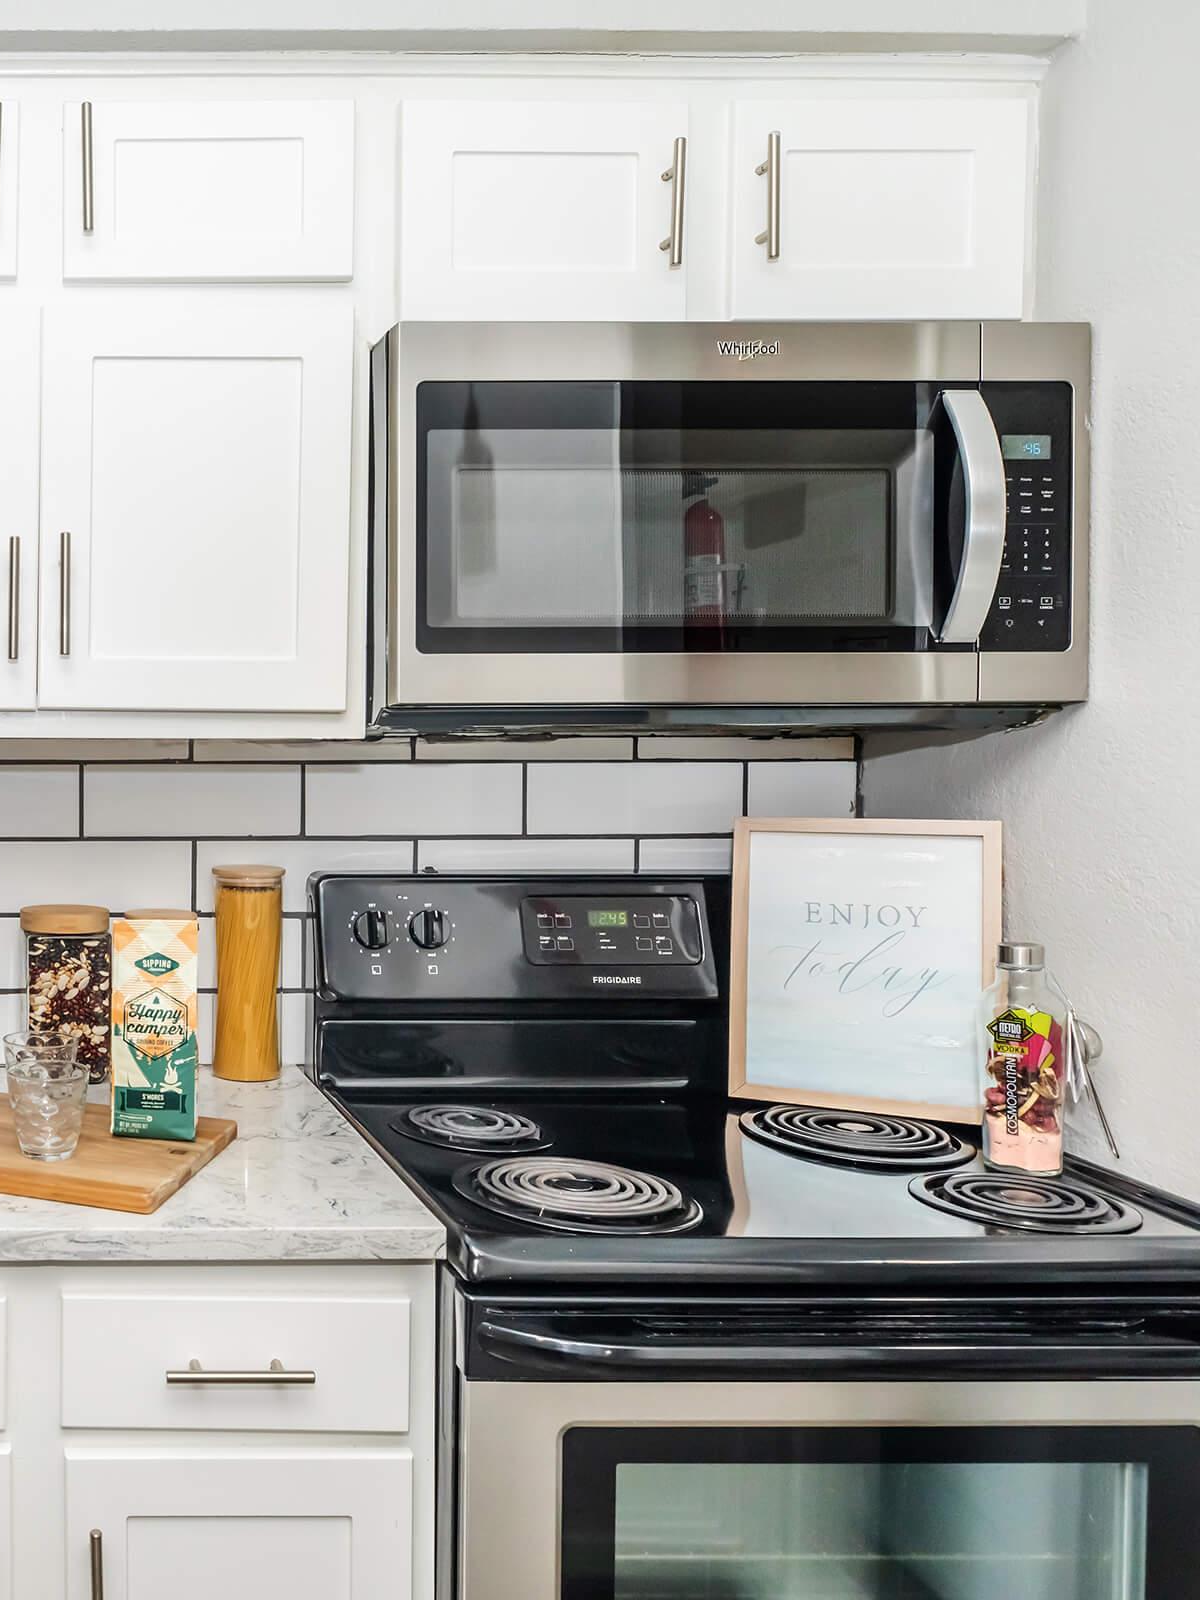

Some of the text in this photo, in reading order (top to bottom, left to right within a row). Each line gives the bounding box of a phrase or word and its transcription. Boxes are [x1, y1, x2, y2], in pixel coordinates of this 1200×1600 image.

[716, 340, 780, 359] Whirlpool
[804, 901, 928, 929] ENJOY
[142, 959, 172, 969] SIPPING
[592, 976, 642, 984] FRIGIDAIRE
[767, 930, 956, 1018] today
[129, 1004, 185, 1024] Happy
[127, 1023, 185, 1038] camper
[995, 1044, 1025, 1054] VODKA
[1006, 1056, 1019, 1136] COSMOPOLITAN
